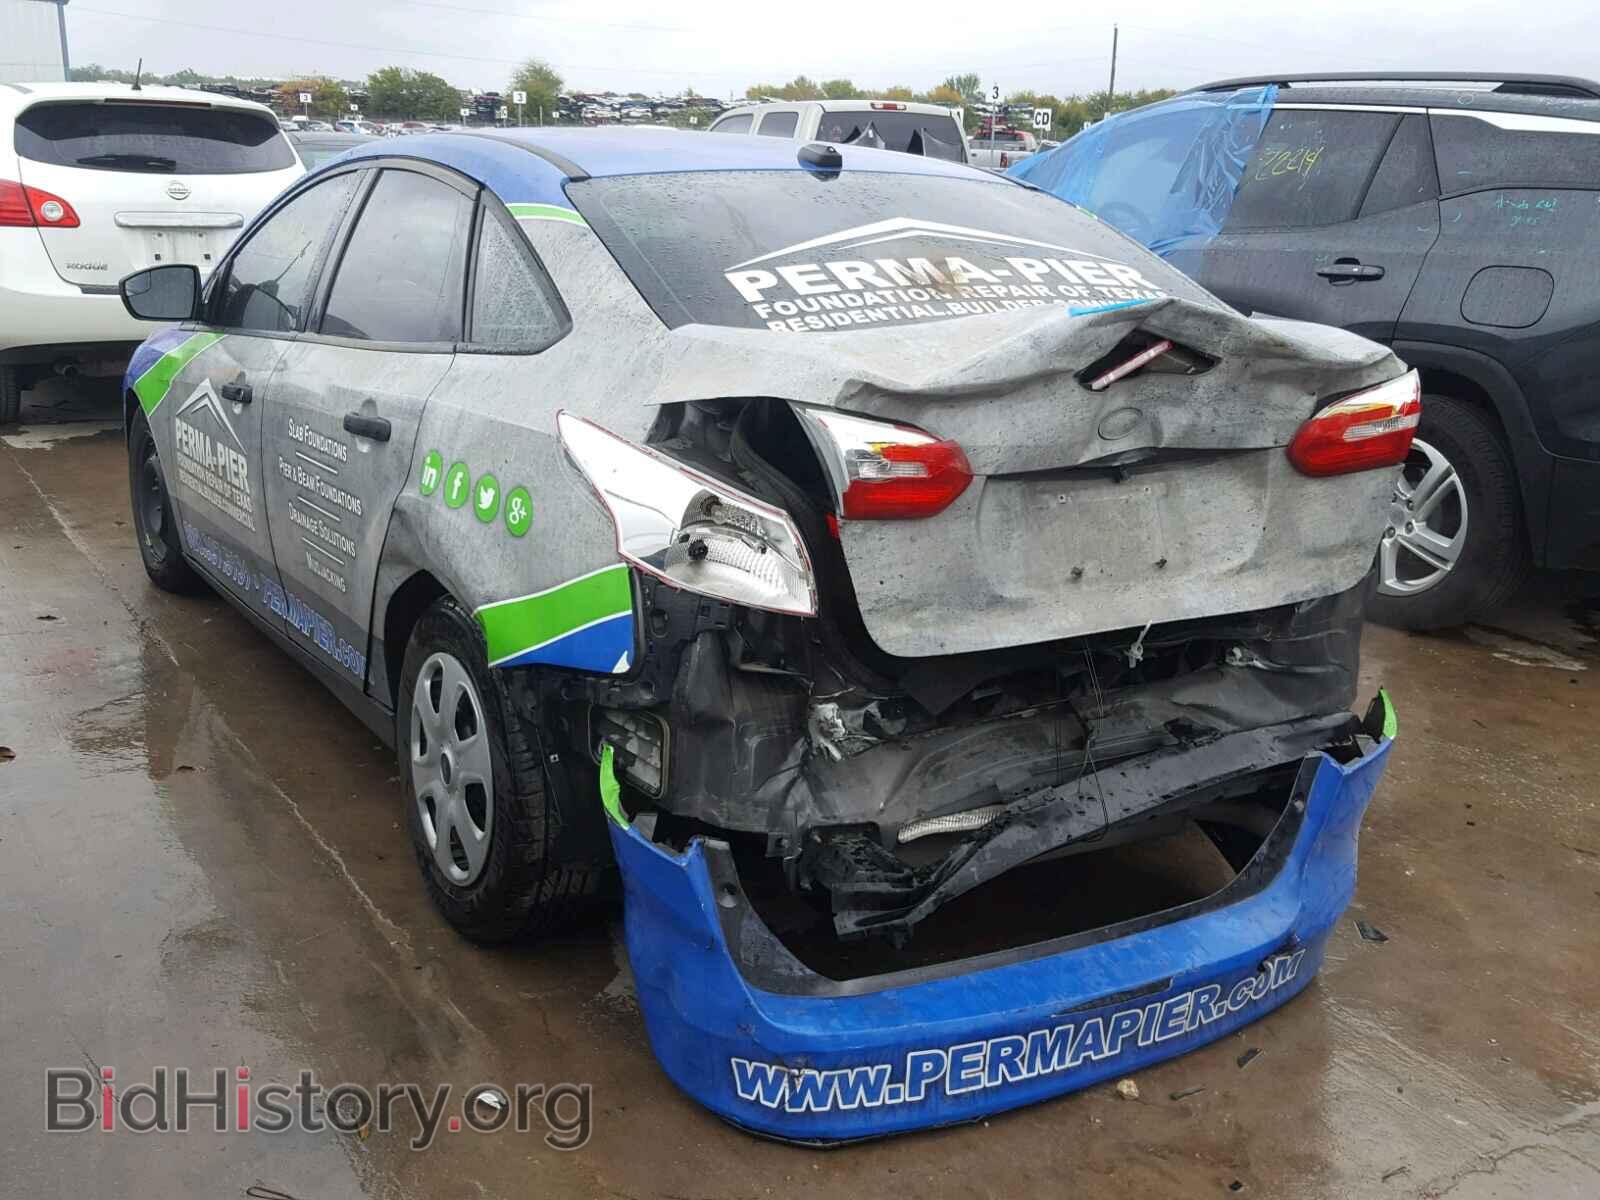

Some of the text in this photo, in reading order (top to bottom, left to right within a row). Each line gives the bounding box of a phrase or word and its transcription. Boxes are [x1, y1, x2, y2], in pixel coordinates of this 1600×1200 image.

[992, 85, 1000, 100] 3
[1034, 111, 1050, 126] CD
[724, 256, 1162, 301] PERMA-PIER
[752, 287, 953, 320] FOUNDATION
[955, 284, 1057, 299] REPAIR
[1057, 284, 1091, 298] OF
[175, 417, 251, 495] PERMA-PIER
